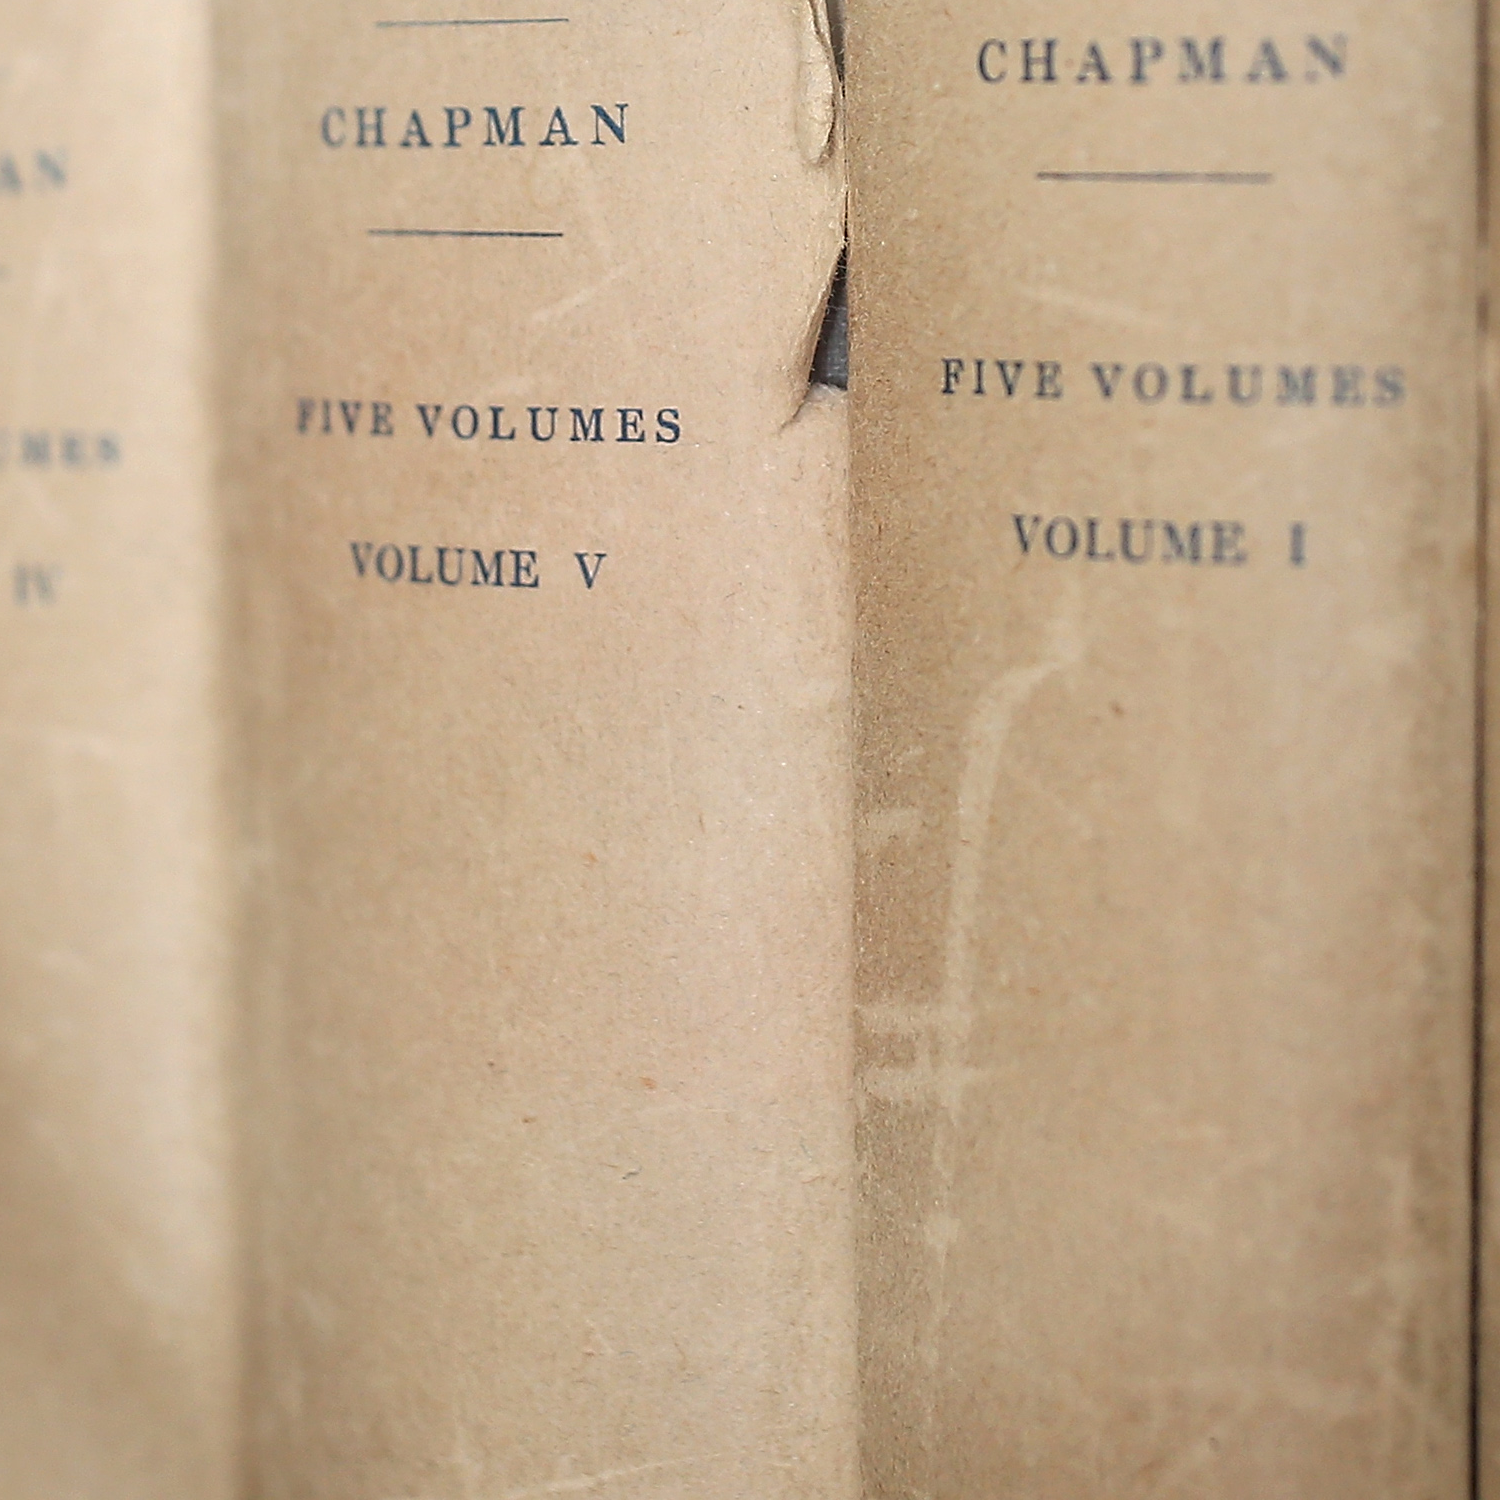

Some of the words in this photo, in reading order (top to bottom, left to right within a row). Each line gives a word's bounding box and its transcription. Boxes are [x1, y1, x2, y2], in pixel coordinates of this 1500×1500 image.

[977, 33, 1350, 86] CHAPMAN
[321, 103, 630, 147] CHAPMAN
[940, 357, 1065, 401] FIVE
[1093, 362, 1407, 407] VOLUMES
[295, 398, 394, 439] FIVE
[416, 404, 682, 442] VOLUMES
[1013, 515, 1248, 565] VOLUME
[1287, 523, 1309, 566] I
[350, 542, 540, 589] VOLUME
[575, 551, 608, 590] V
